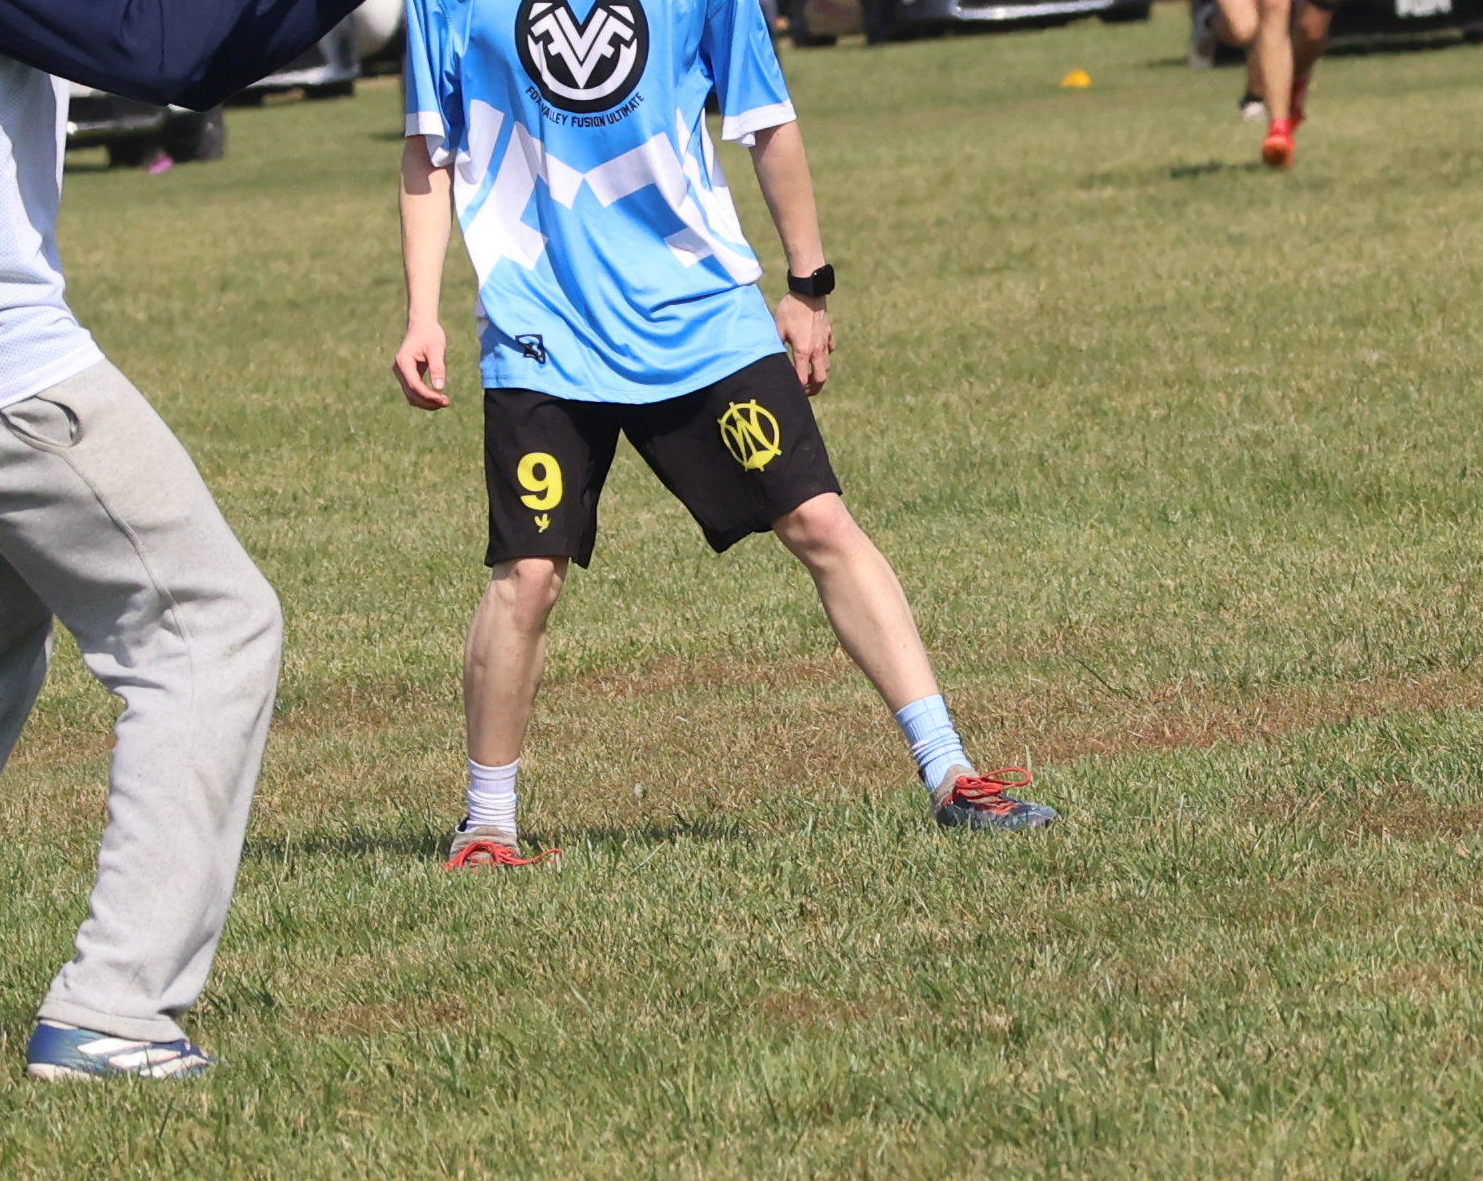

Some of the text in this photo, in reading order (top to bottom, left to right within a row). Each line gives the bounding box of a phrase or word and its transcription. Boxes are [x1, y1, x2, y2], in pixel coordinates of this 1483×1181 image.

[540, 103, 569, 126] VALLEY
[570, 116, 606, 128] FUSION
[605, 91, 645, 125] ULTIMATE
[517, 452, 563, 511] 9
